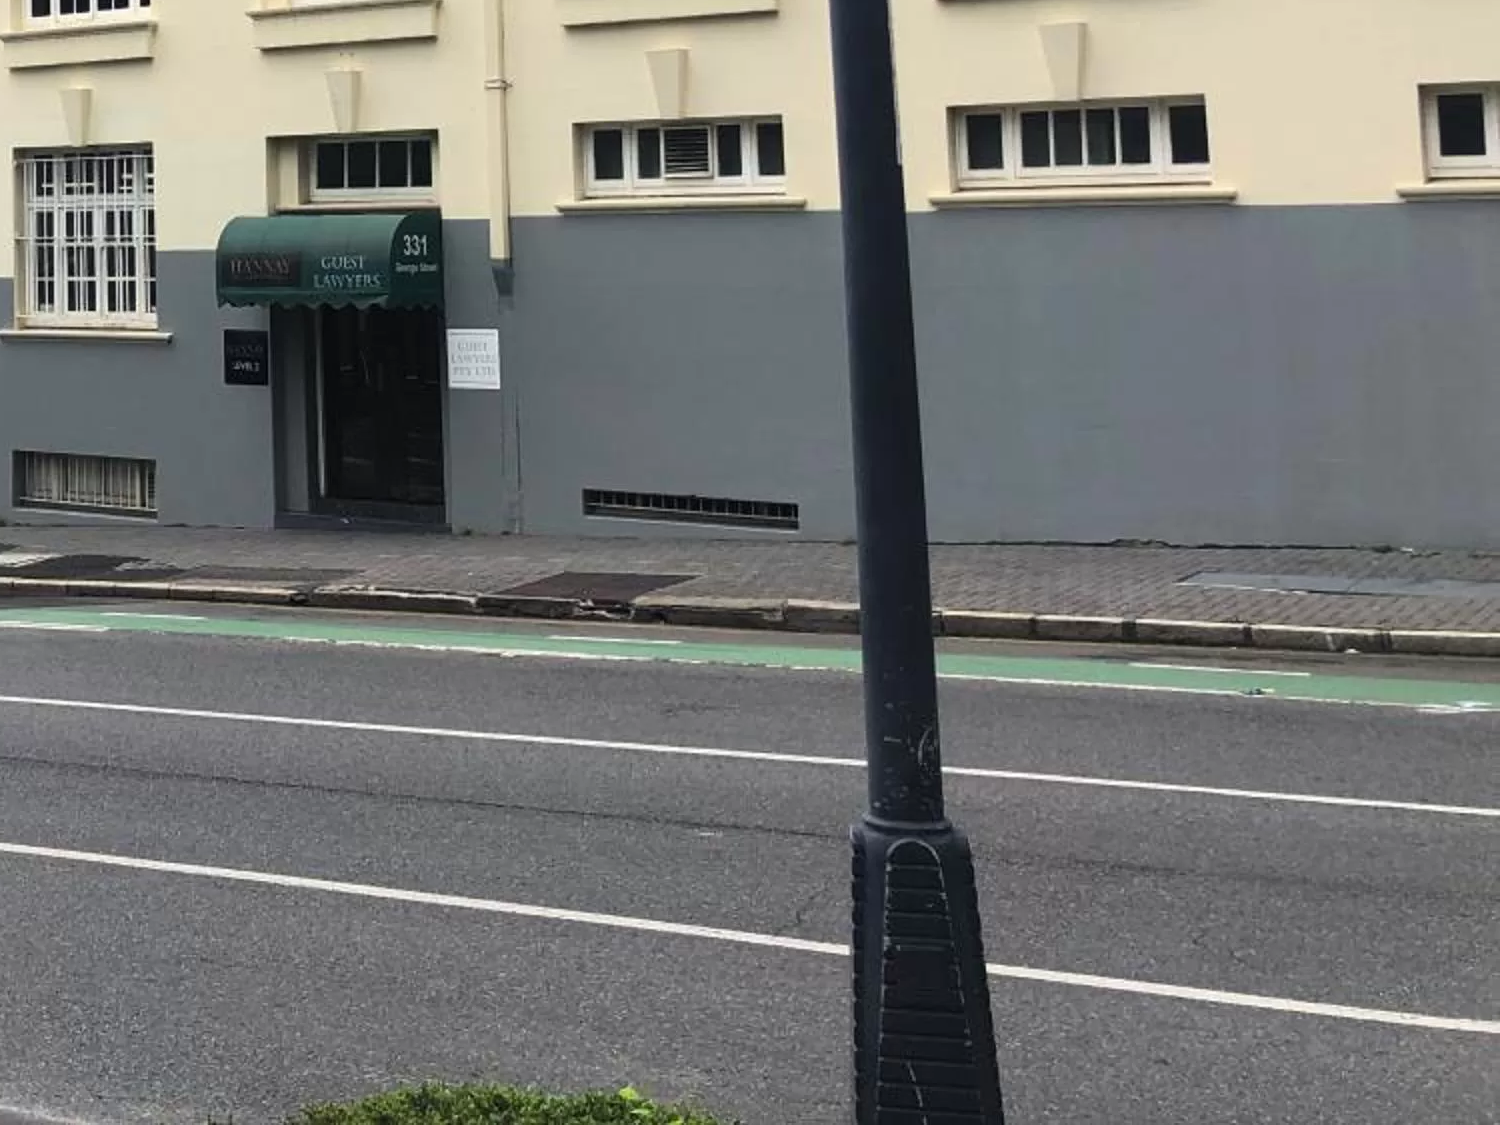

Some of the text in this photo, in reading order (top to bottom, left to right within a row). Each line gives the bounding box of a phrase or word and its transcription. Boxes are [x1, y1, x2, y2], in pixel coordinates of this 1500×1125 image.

[403, 234, 428, 256] 331
[320, 254, 366, 270] GUEST
[313, 273, 381, 289] LAWYERS
